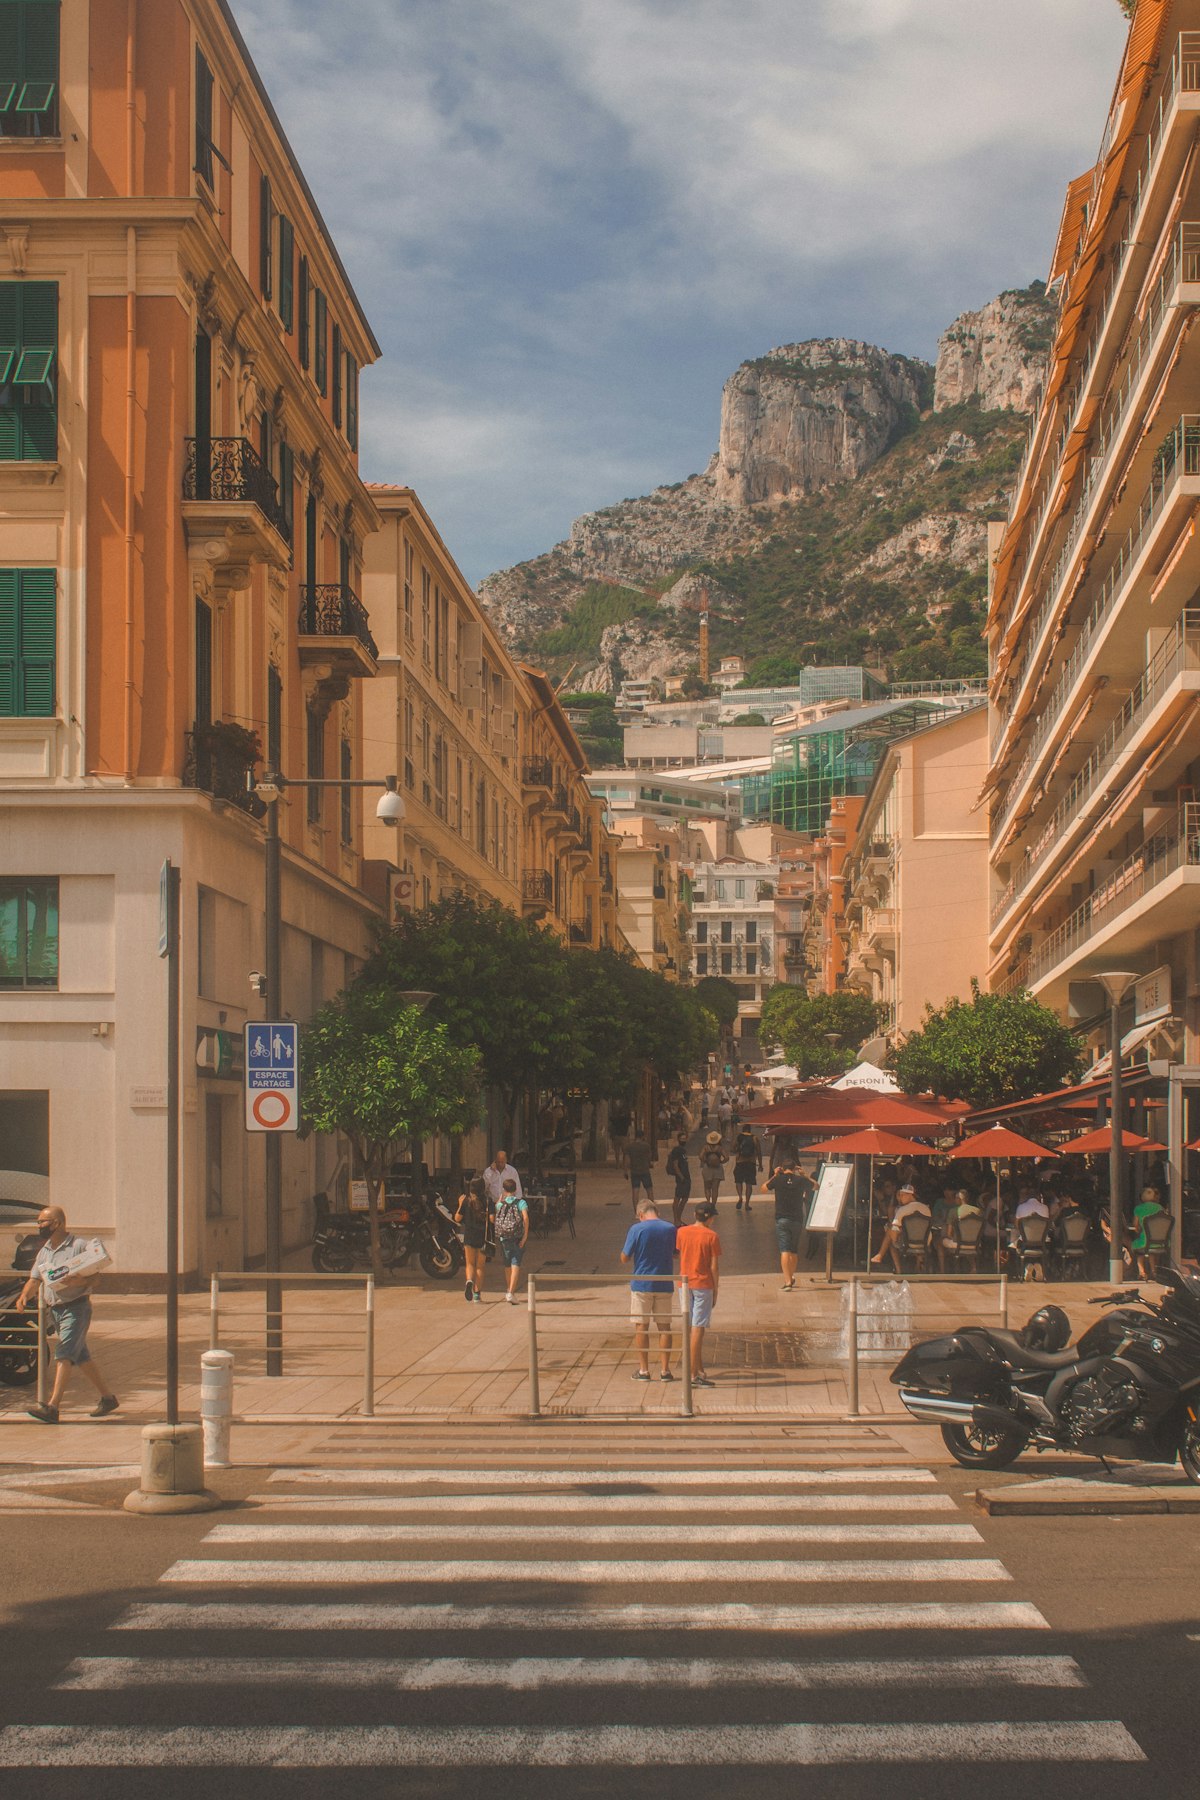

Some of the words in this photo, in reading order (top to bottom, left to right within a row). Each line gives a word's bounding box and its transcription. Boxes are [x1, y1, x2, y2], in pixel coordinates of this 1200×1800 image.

[255, 1071, 288, 1079] ESPACE
[252, 1080, 291, 1088] PARTAGE
[845, 1078, 885, 1086] PERONI
